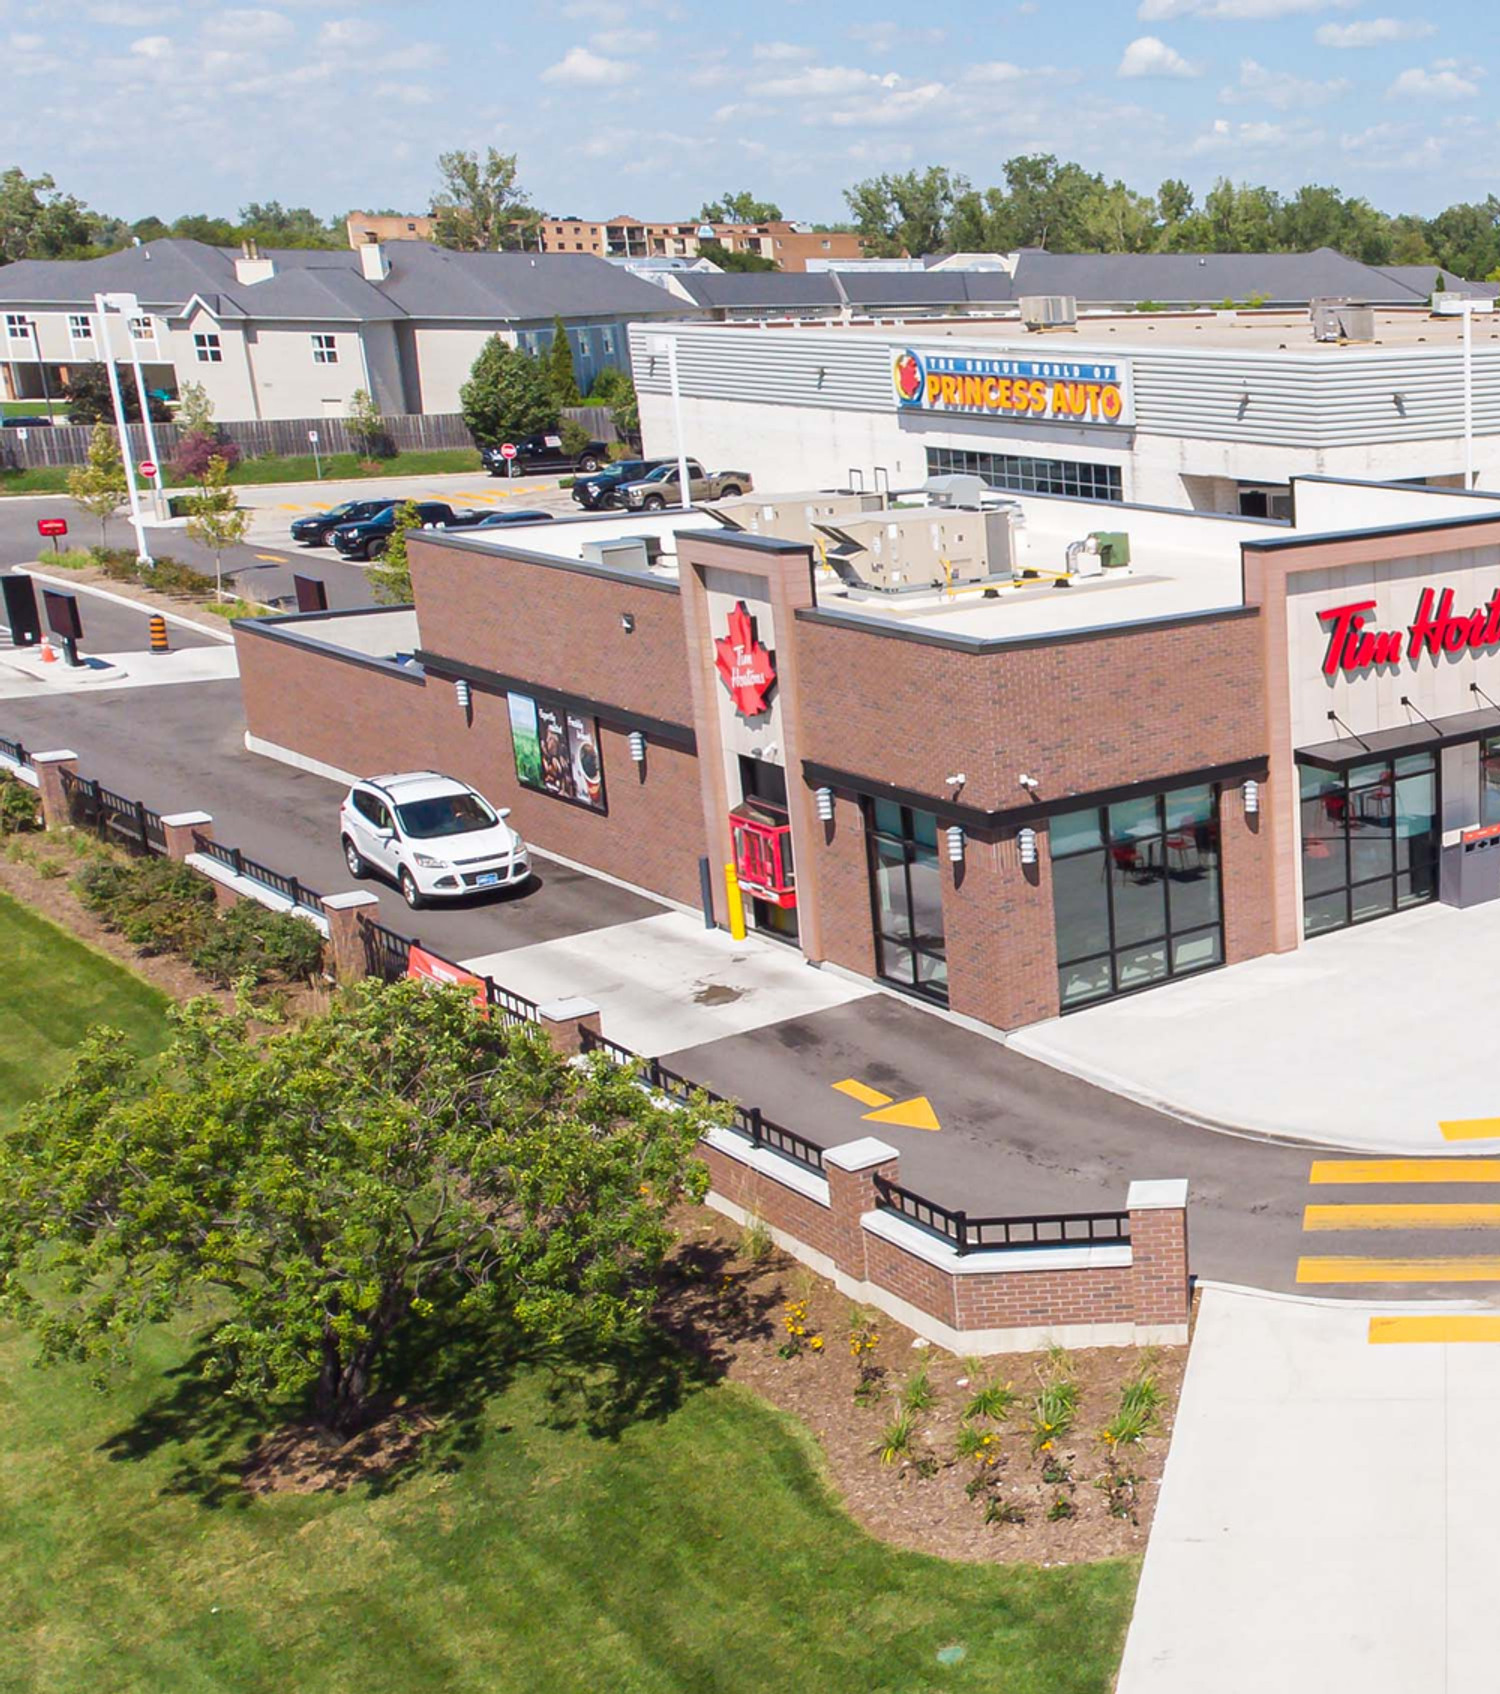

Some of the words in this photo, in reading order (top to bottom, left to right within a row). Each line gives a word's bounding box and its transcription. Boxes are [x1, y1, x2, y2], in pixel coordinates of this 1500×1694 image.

[966, 359, 1019, 375] UNIQUE
[1032, 363, 1080, 378] WORLD
[926, 375, 1048, 412] PRINCESS
[1051, 382, 1122, 418] AUTO
[1318, 599, 1403, 677] Tim
[733, 644, 753, 667] Tim
[731, 667, 766, 689] Hortons
